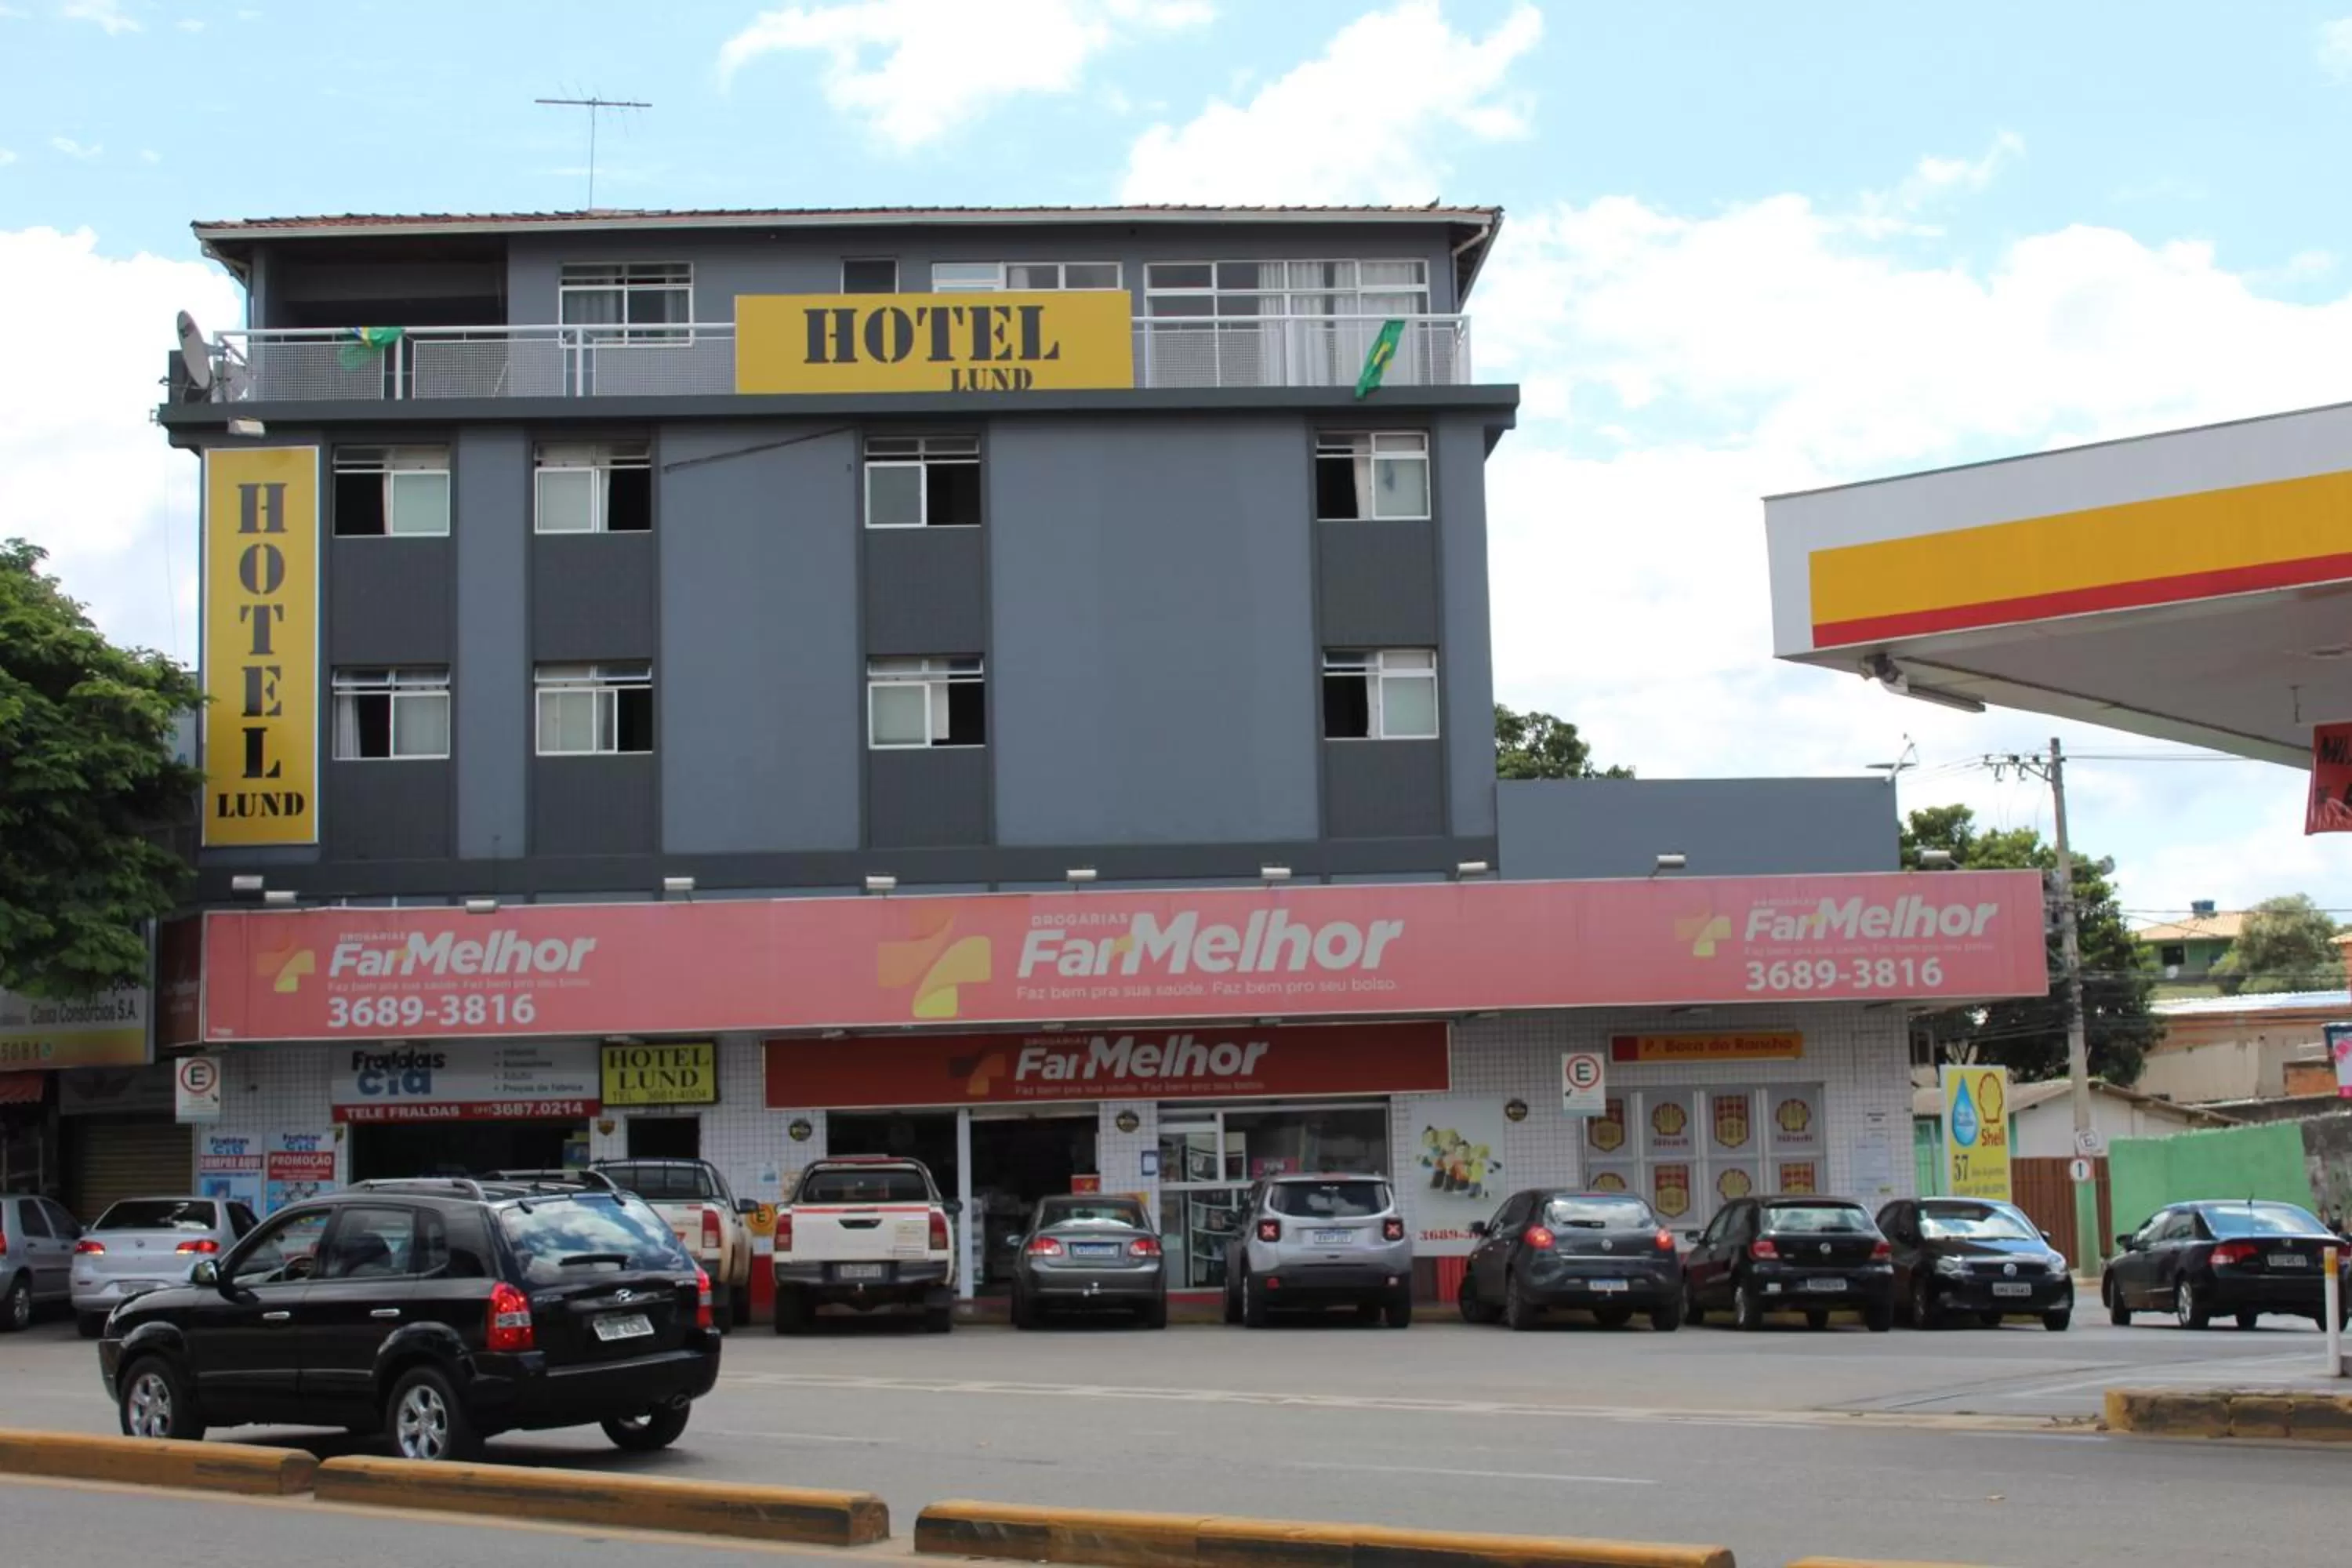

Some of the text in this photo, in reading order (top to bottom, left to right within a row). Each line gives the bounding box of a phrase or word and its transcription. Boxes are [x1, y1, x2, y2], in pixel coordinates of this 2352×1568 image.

[803, 304, 1060, 365] HOTEL
[950, 368, 1034, 393] LUND
[237, 481, 289, 779] HOTEL
[216, 792, 305, 819] LUND
[1031, 913, 1128, 927] DROGARIAS
[1744, 894, 1998, 942] FarMelhor
[328, 929, 597, 978] FarMelhor
[1016, 908, 1405, 979] FarMelhor
[1745, 956, 1944, 992] 3689-3816
[1017, 985, 1046, 1000] Faz
[1051, 985, 1087, 999] bem
[1091, 986, 1119, 1000] pra
[1123, 985, 1151, 998] sua
[1213, 981, 1241, 995] Faz
[1246, 979, 1283, 994] bem
[1287, 981, 1314, 996] pro
[1319, 980, 1347, 993] seu
[326, 993, 536, 1028] 3689-3816
[609, 1047, 710, 1069] HOTEL
[1015, 1034, 1269, 1081] FarMelhor
[191, 1066, 205, 1085] E
[619, 1069, 699, 1090] LUND
[1576, 1062, 1591, 1082] E
[345, 1107, 380, 1120] TELE
[389, 1105, 460, 1120] FRALDAS
[1981, 1127, 2005, 1147] Shell
[270, 1152, 333, 1168] PROMOÇÃO
